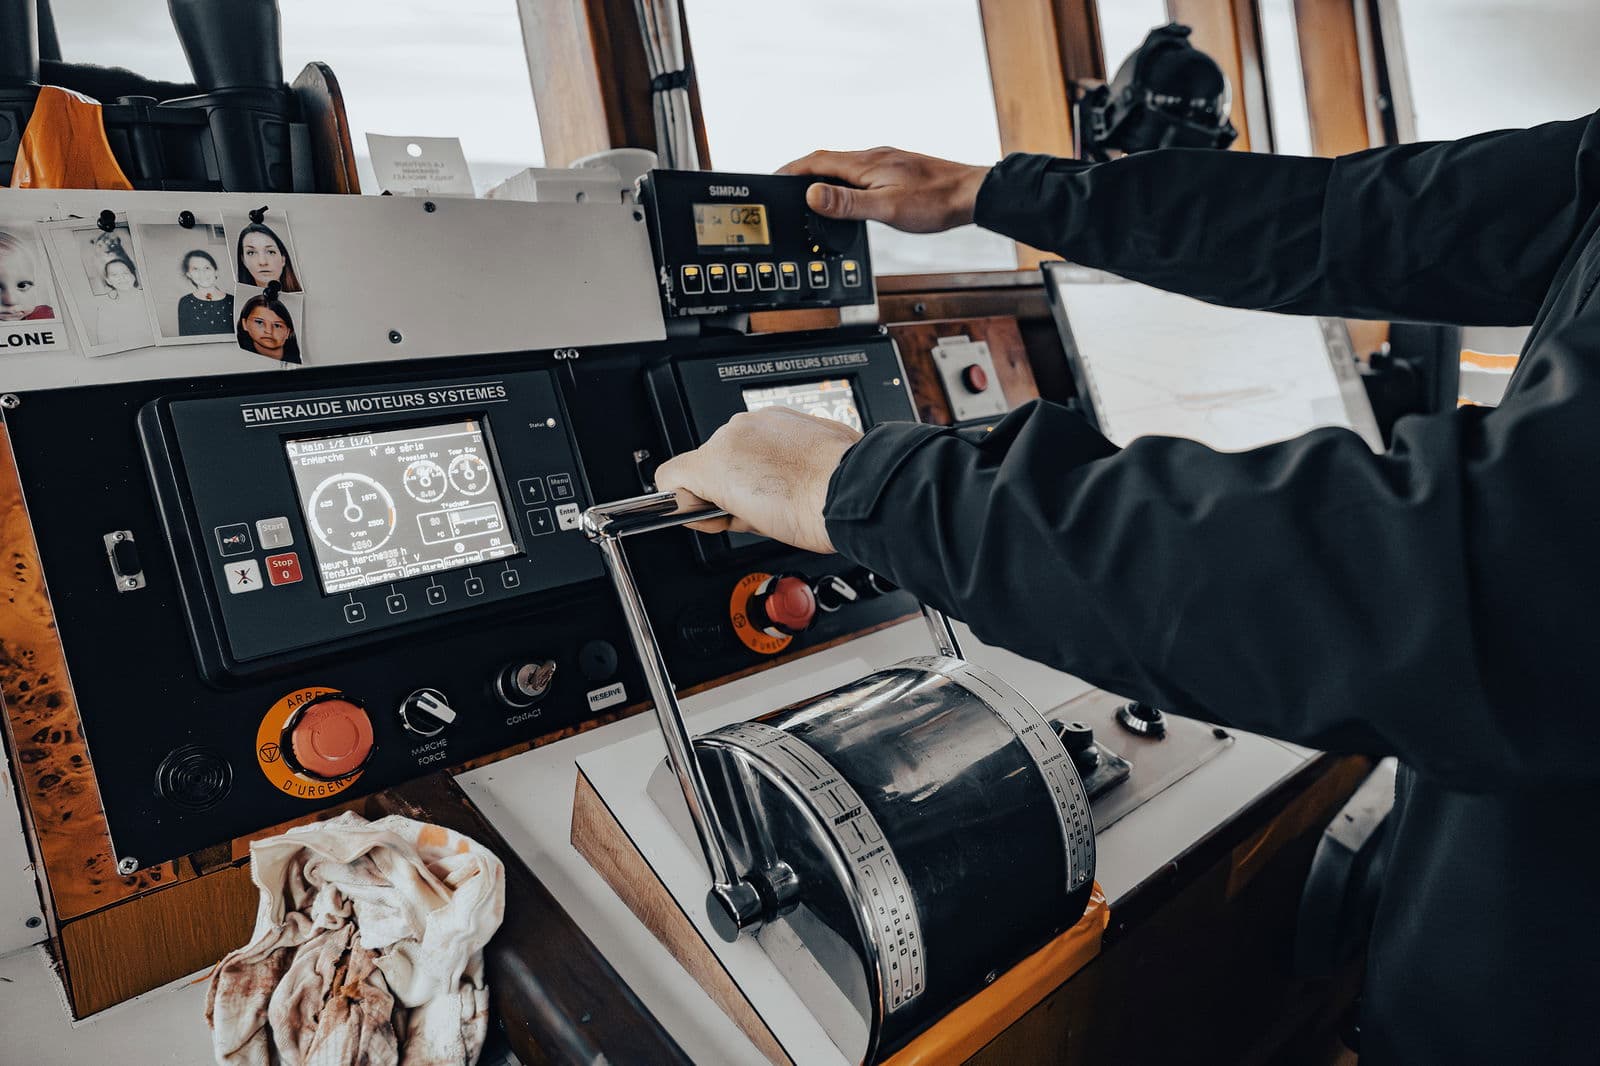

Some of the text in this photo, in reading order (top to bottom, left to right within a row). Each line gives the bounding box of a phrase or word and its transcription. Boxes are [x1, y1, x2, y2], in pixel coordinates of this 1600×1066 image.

[709, 185, 750, 197] SIMRAD
[718, 351, 869, 378] EMERAUDE MOTEURS SYSTEMES
[242, 385, 507, 423] EMERAUDE MOTEURS SYSTEMES
[329, 440, 344, 449] 1/2
[560, 507, 576, 515] Enter
[262, 523, 284, 532] Start
[272, 559, 294, 568] Stop
[322, 566, 361, 579] Tension
[413, 553, 420, 562] V
[590, 687, 622, 703] RESERVE
[506, 708, 542, 726] CONTACT
[411, 738, 448, 757] MARCHE
[418, 752, 447, 766] FORCE
[834, 806, 862, 826] KOBELT
